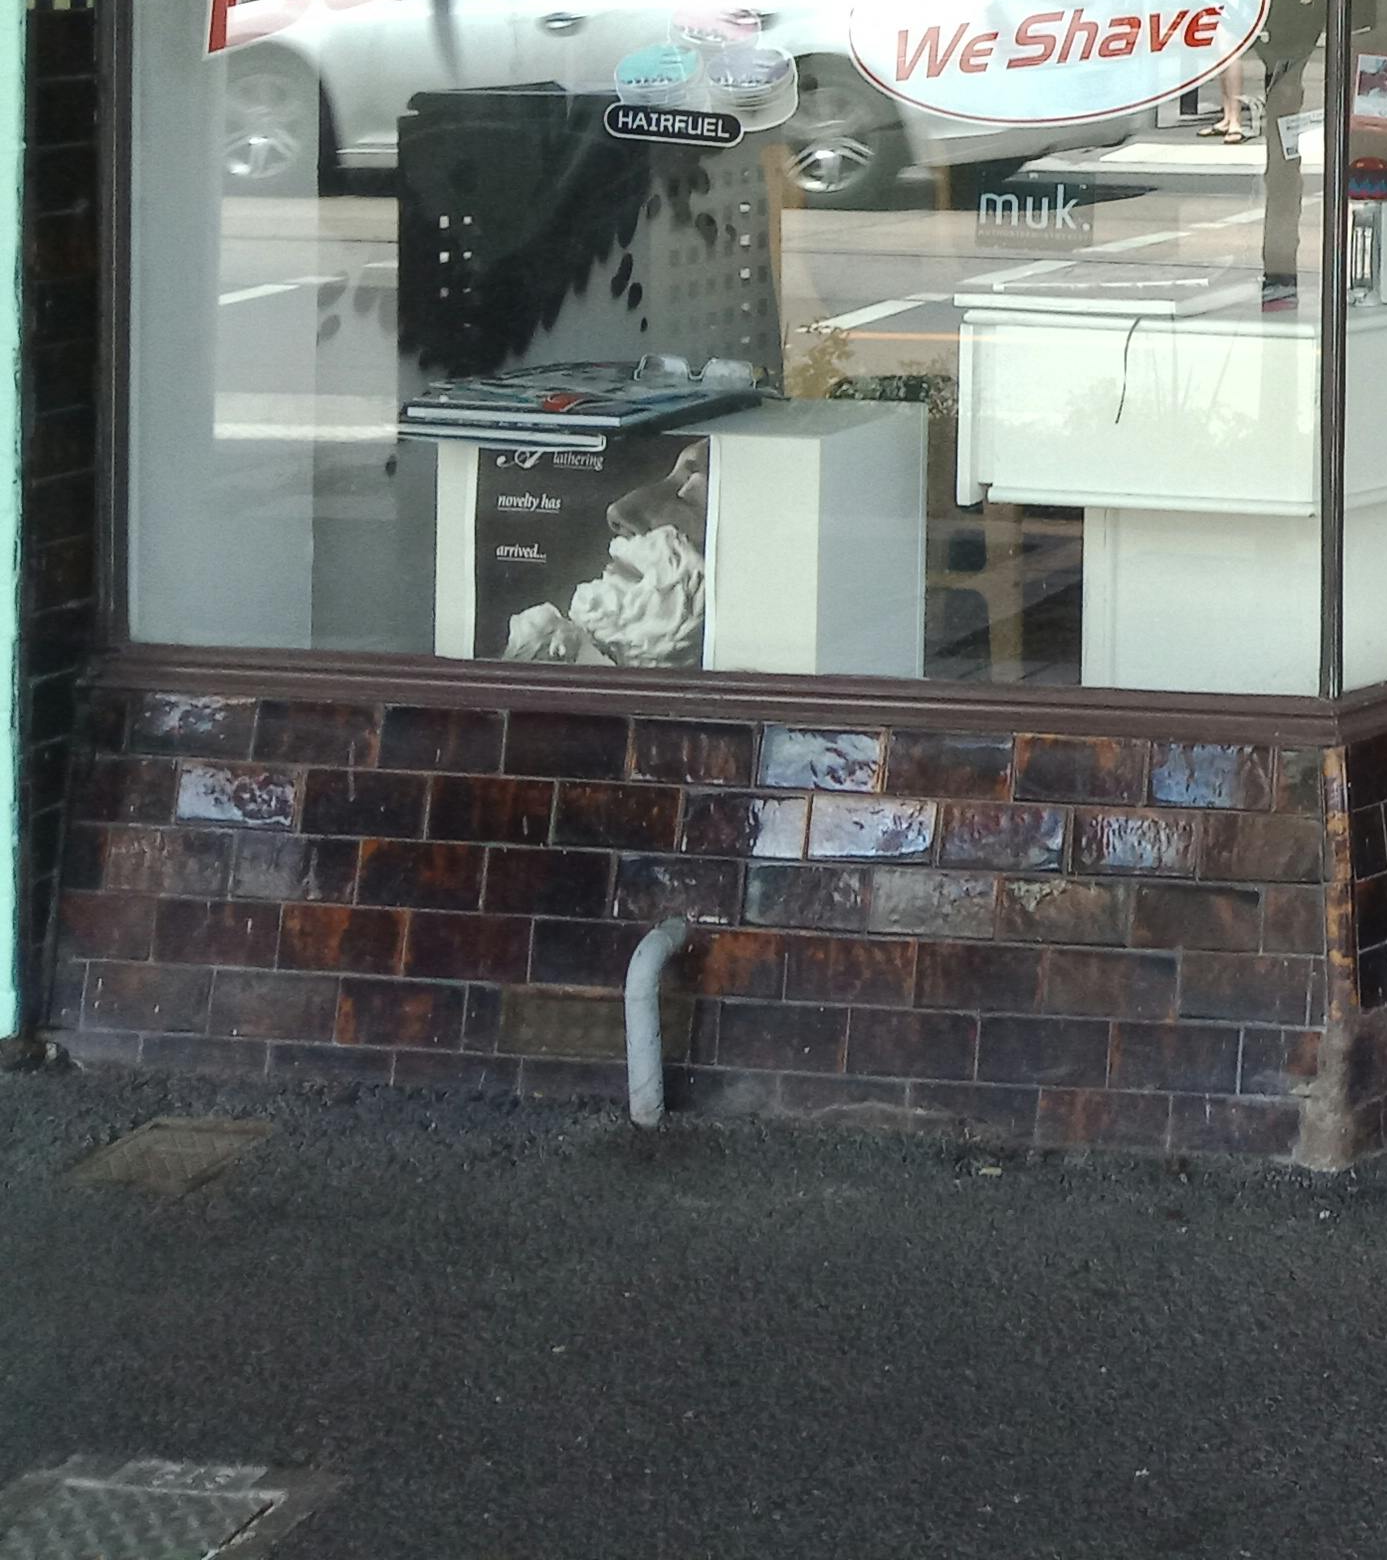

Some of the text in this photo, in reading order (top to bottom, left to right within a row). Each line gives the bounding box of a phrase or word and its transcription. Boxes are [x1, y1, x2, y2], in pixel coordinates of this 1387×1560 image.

[894, 4, 1226, 82] We Shave
[617, 109, 731, 139] HAIRFUEL
[497, 491, 562, 512] novelty has
